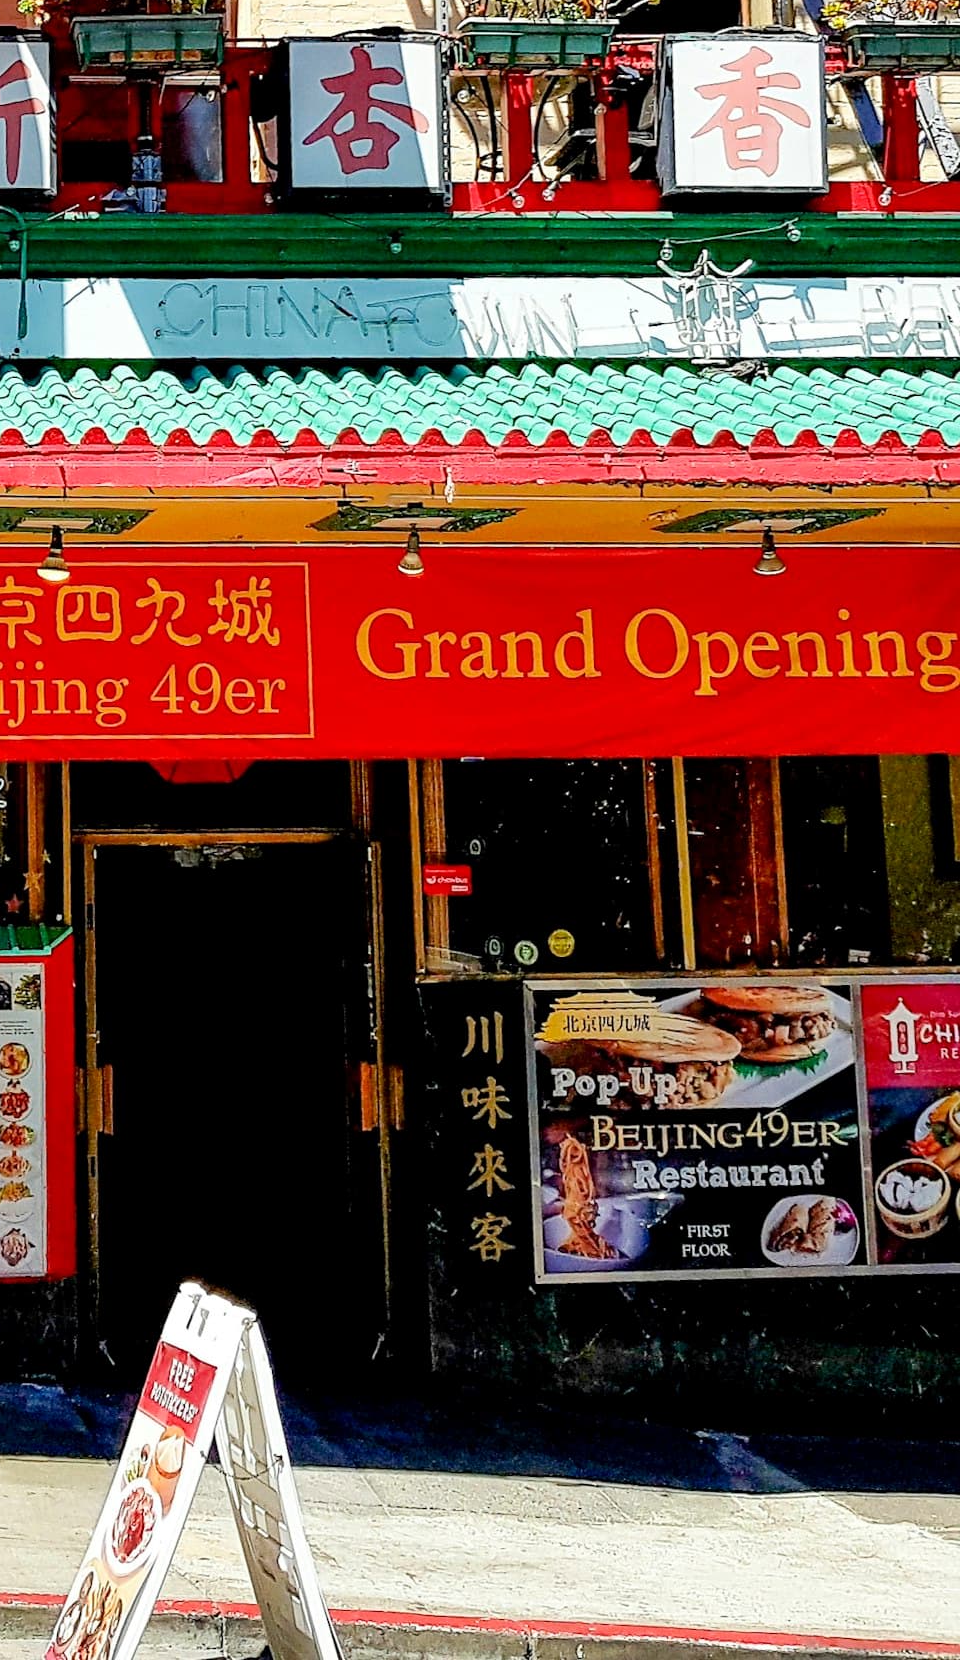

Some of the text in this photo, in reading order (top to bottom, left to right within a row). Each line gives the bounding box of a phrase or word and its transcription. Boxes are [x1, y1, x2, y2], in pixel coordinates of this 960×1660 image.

[302, 46, 429, 176] 杏
[692, 45, 811, 177] 香
[356, 608, 960, 696] Grand Opening
[150, 662, 286, 714] 49er
[551, 1067, 677, 1106] Pop-Up
[461, 1011, 516, 1262] 川味來客
[632, 1158, 826, 1190] Restaurant
[682, 1244, 732, 1258] FLOOR
[687, 1224, 731, 1239] FIRST
[170, 1358, 196, 1393] FREE
